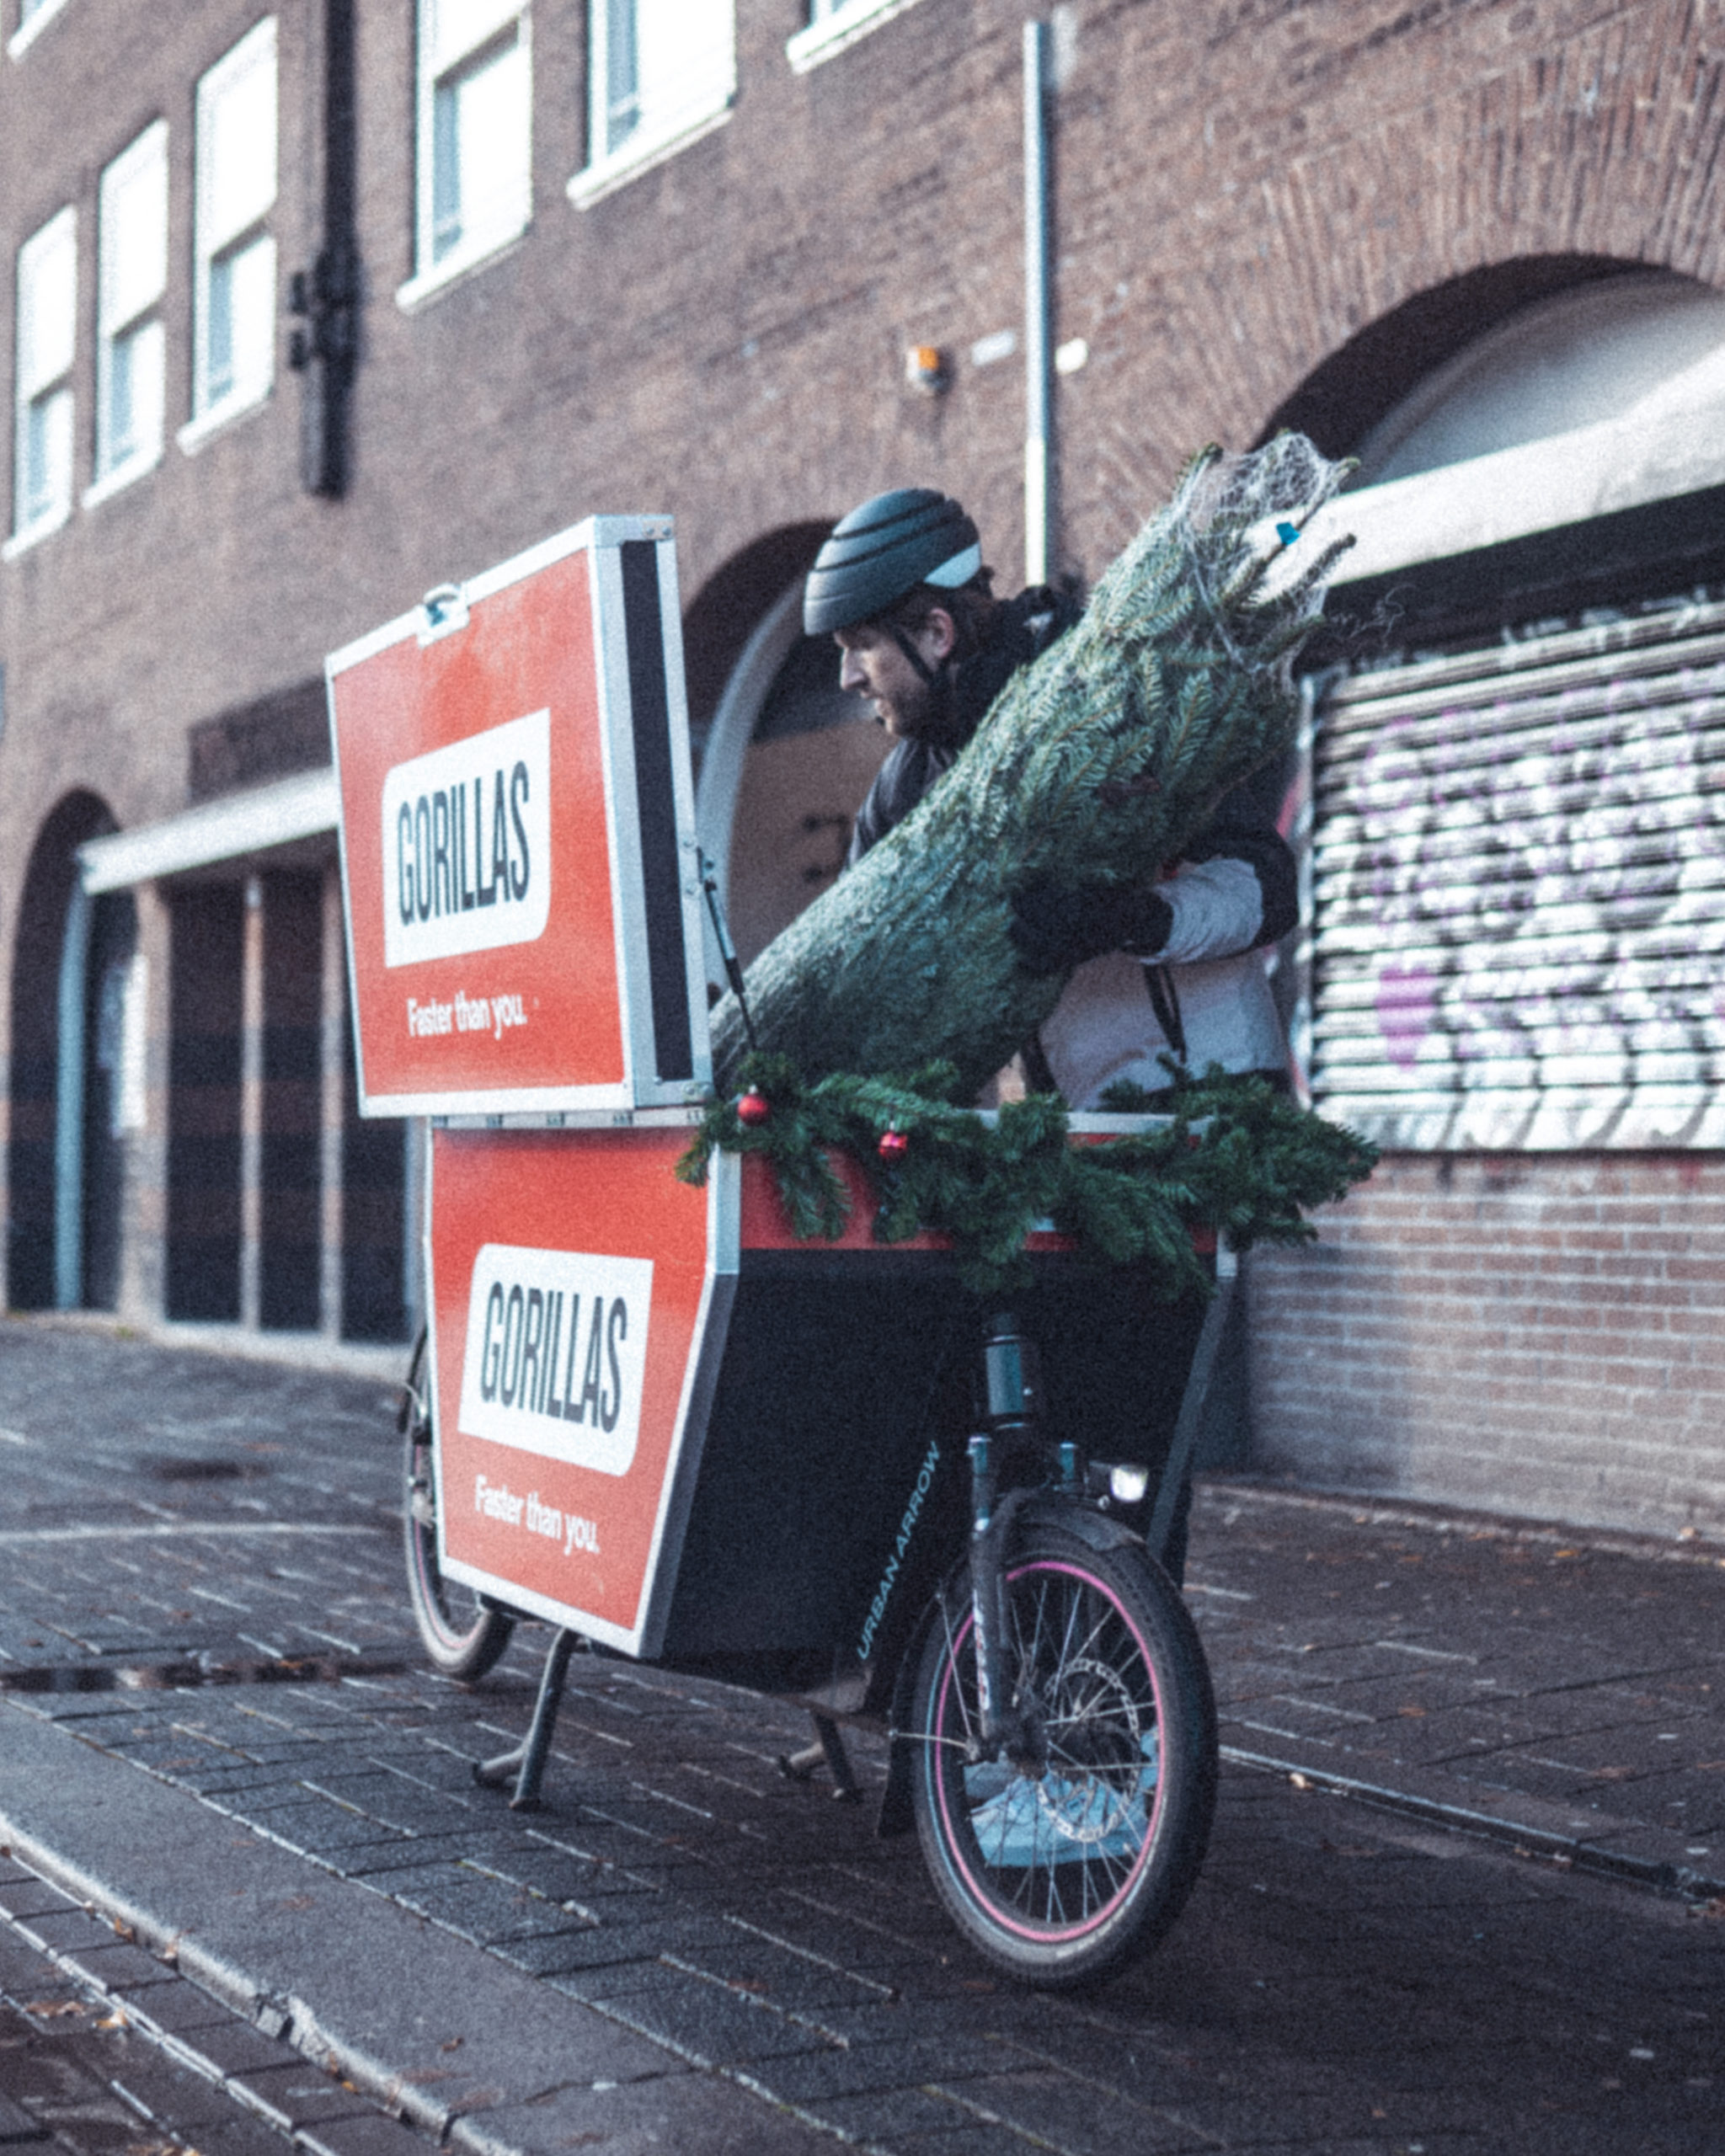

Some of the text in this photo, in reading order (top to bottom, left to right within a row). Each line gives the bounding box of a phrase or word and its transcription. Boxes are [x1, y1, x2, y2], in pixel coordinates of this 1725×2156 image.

[398, 760, 530, 926] GORILLAS
[407, 989, 528, 1040] Faster than you.
[481, 1281, 628, 1433] GORILLAS
[475, 1474, 601, 1556] Faster than you.
[857, 1440, 940, 1660] URBAN ARROW
